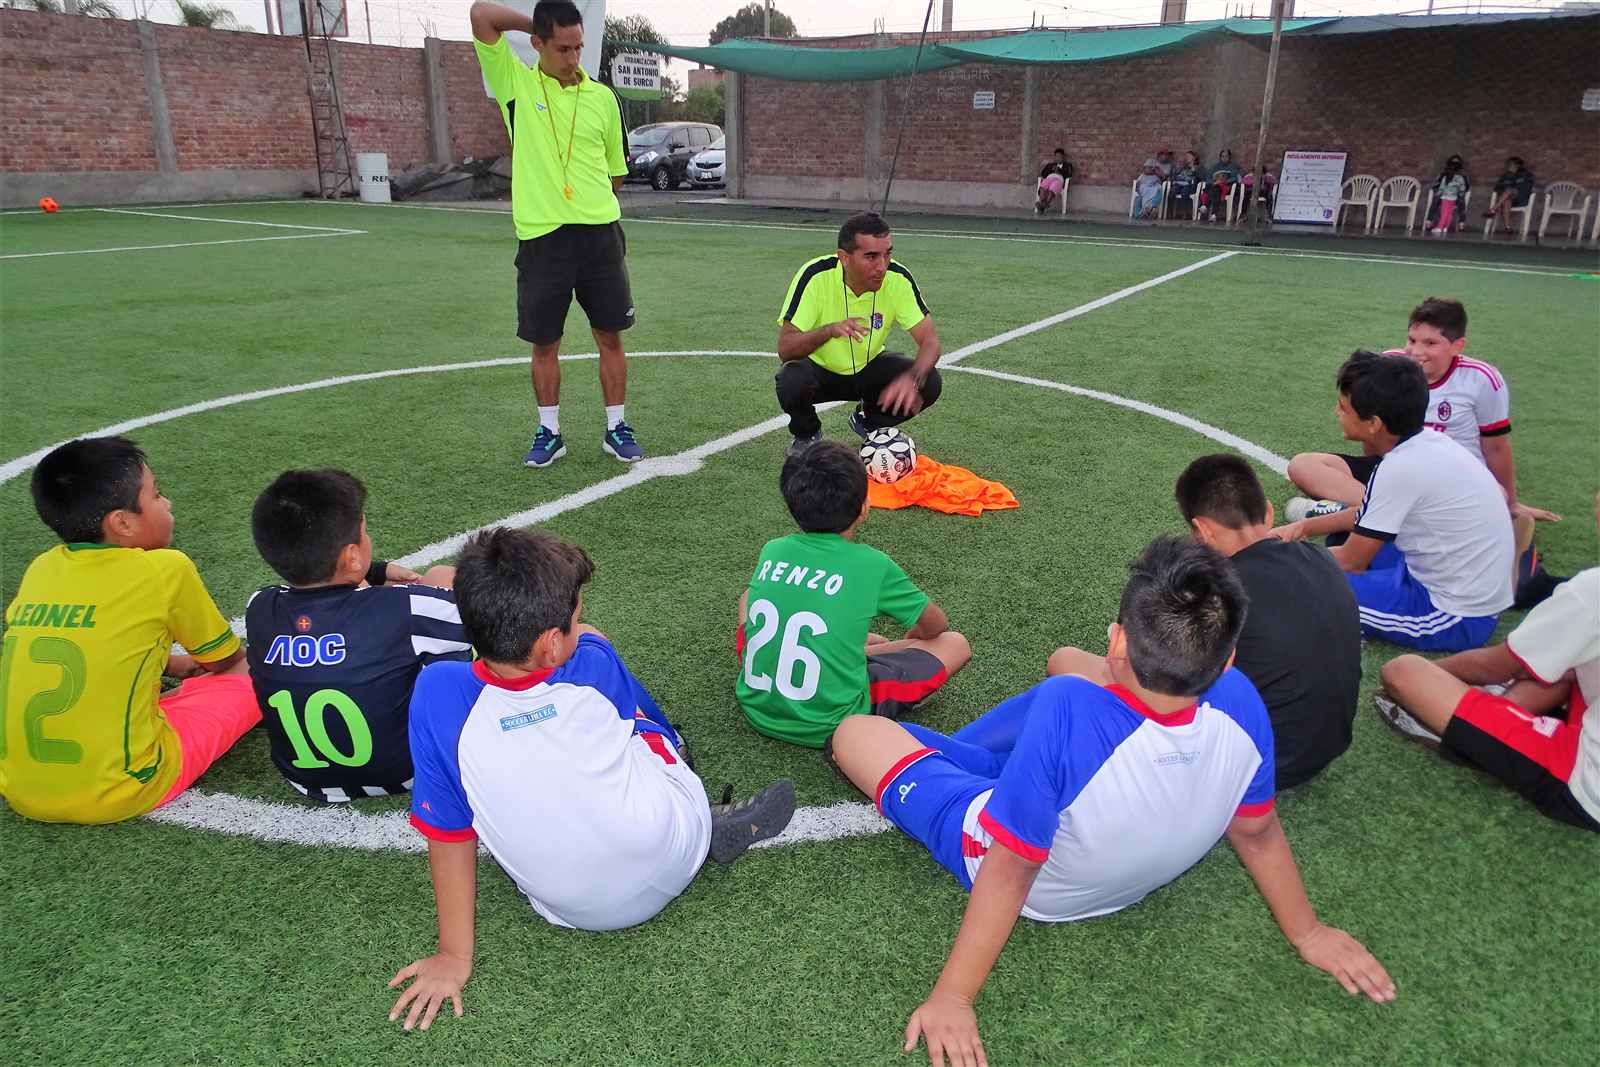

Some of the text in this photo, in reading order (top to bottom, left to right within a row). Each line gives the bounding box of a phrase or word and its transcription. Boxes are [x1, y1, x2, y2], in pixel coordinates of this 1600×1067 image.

[618, 65, 658, 77] SAN ANTONIO
[624, 77, 653, 87] DE SURCO
[758, 560, 844, 595] RENZO
[9, 603, 97, 628] LEONEL
[264, 633, 346, 667] AOC
[744, 598, 829, 701] 26
[267, 688, 373, 769] 10
